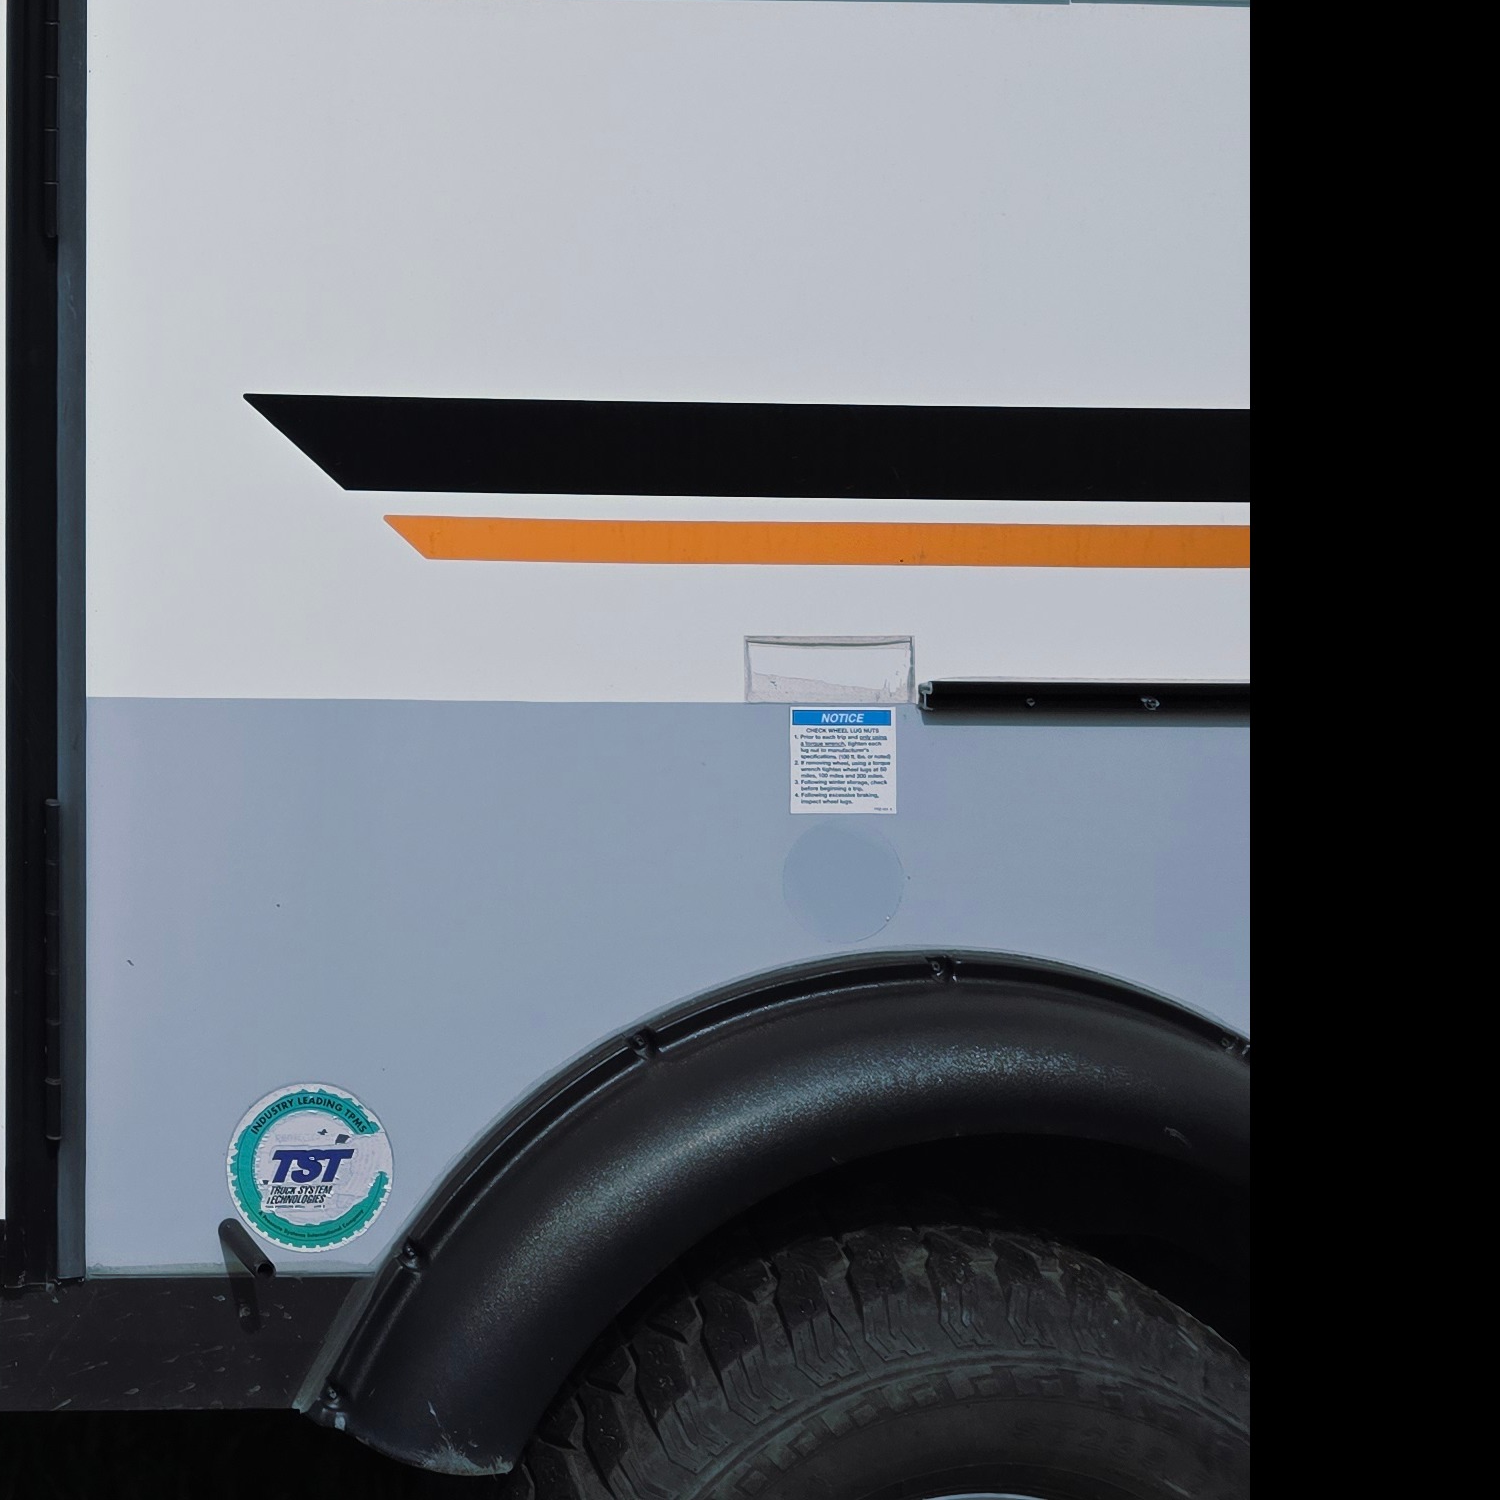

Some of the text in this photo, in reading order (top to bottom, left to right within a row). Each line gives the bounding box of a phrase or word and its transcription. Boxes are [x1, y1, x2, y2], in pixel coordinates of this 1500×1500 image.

[820, 713, 865, 723] NOTICE
[250, 1096, 367, 1135] INDUSTRY LEADING TPMS
[271, 1148, 355, 1184] TST
[270, 1185, 334, 1195] TRUCK SYSTEM
